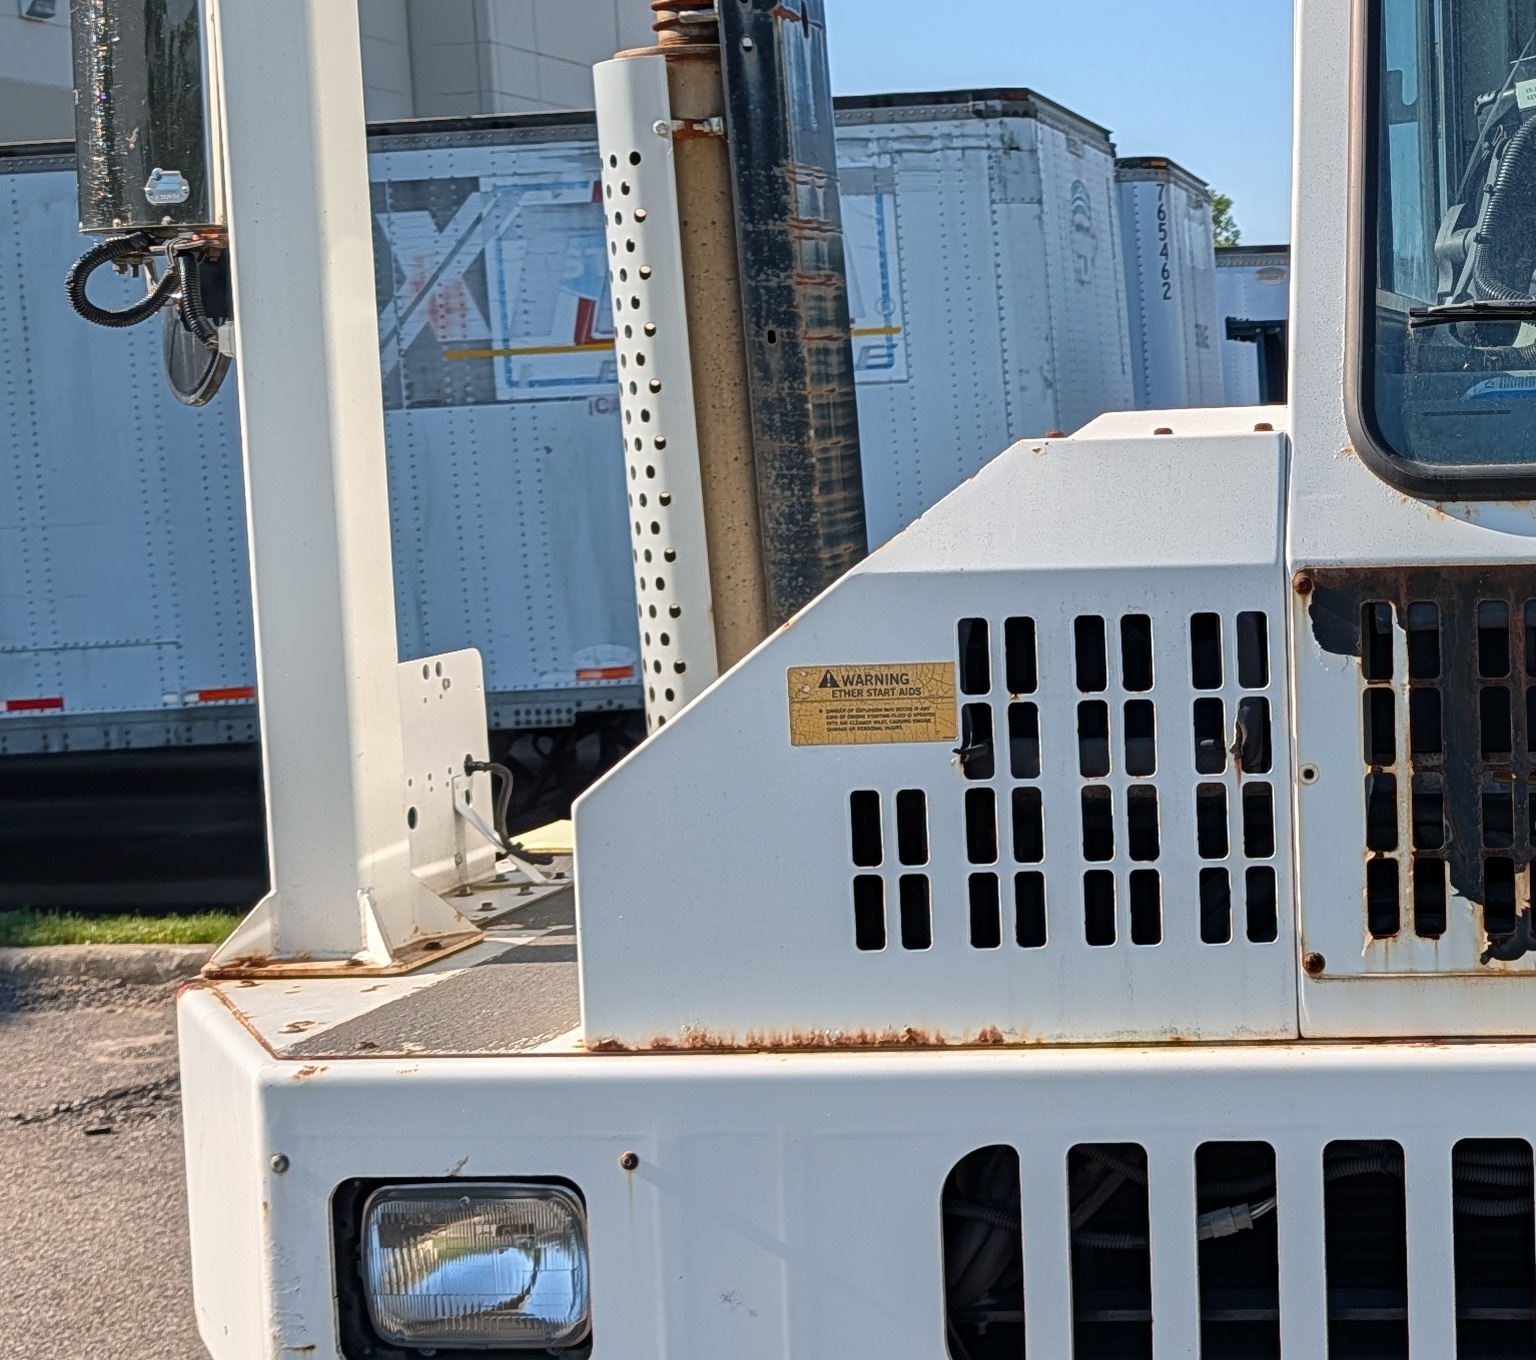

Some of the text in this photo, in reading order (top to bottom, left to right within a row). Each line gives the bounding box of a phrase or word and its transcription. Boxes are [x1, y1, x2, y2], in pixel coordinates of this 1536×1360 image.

[1156, 183, 1172, 300] 765462
[841, 673, 909, 686] WARNING
[831, 687, 922, 698] ETHER START AIDS
